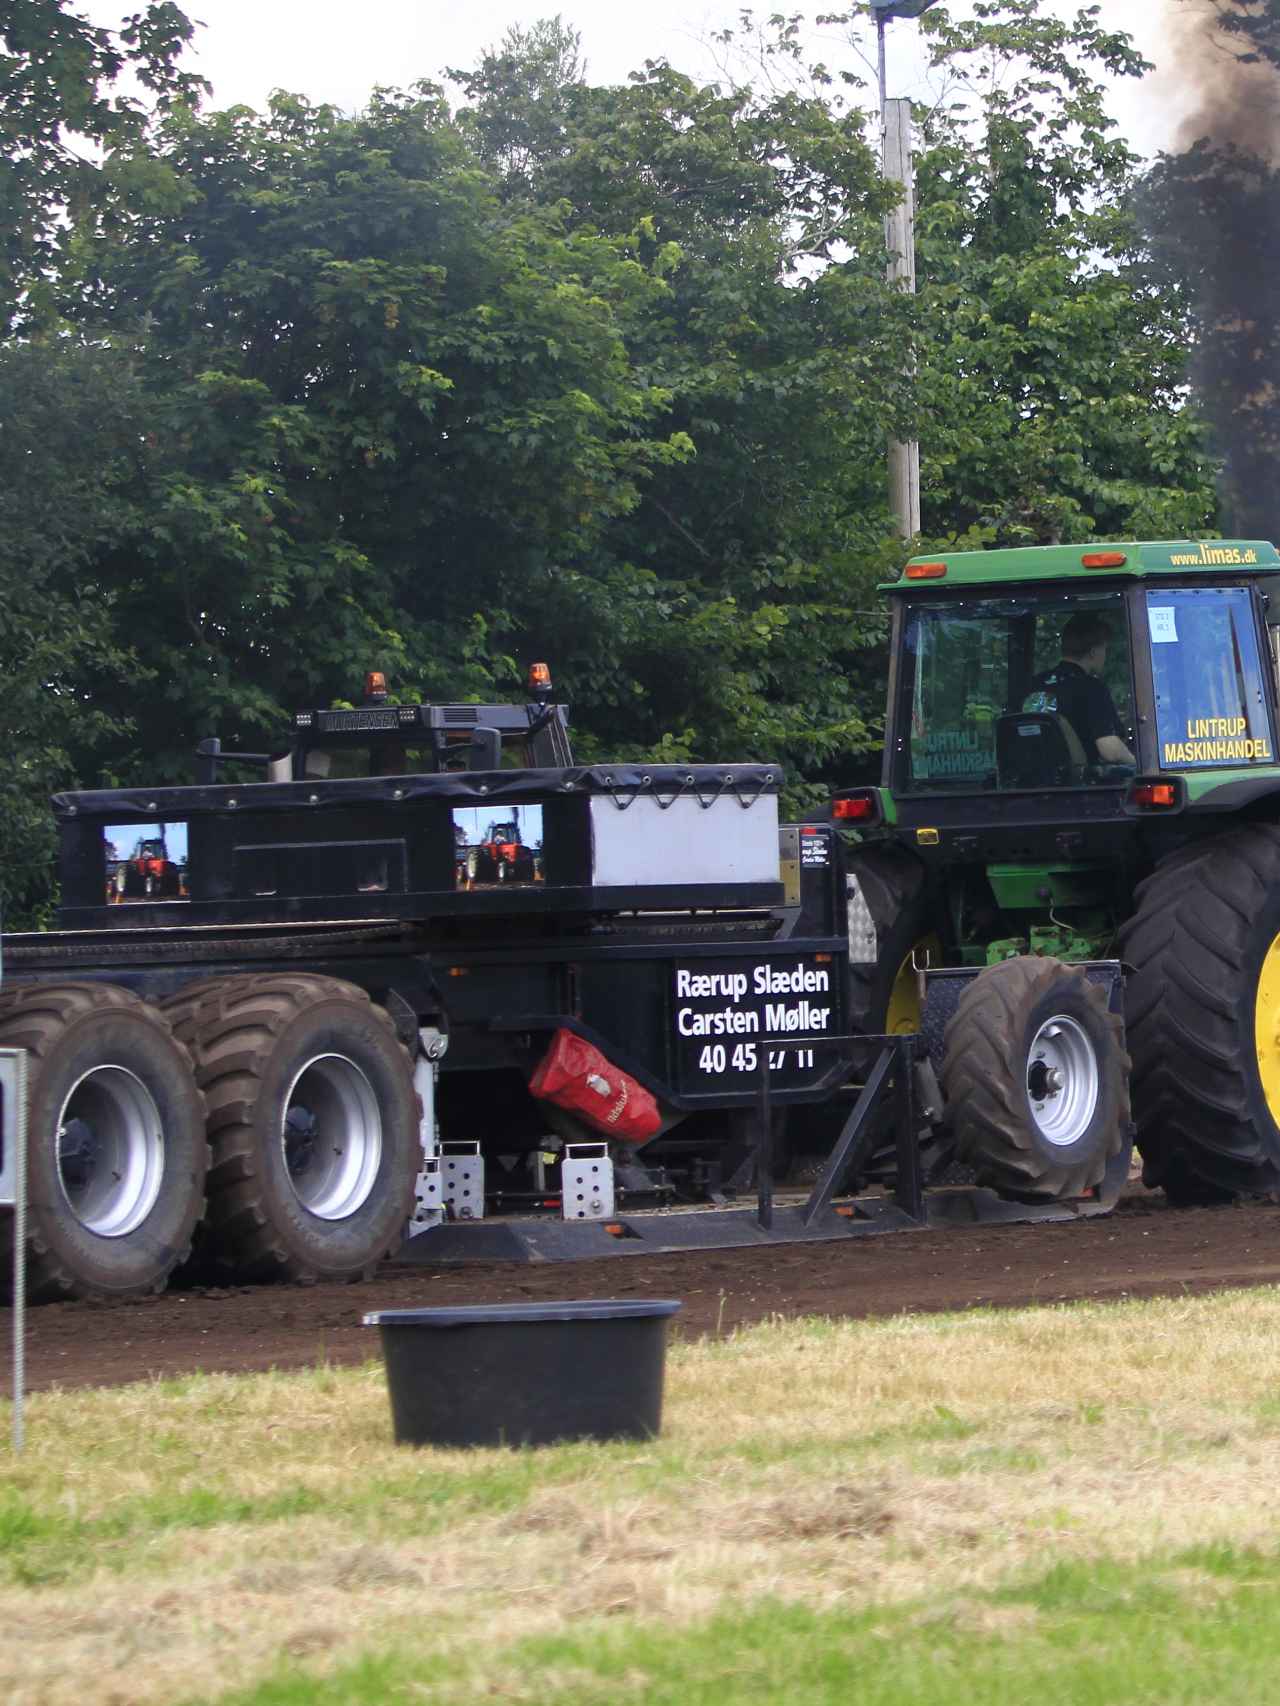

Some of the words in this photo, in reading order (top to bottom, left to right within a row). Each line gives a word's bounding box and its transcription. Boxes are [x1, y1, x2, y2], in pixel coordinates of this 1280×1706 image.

[1170, 544, 1257, 566] www.limas.dk
[1187, 718, 1247, 738] LINTRUP
[1165, 739, 1271, 763] MASKINHANDEL
[677, 969, 748, 1003] Rærup
[753, 963, 829, 995] Slæden
[678, 1006, 759, 1037] Carsten
[765, 1000, 830, 1032] Møller
[699, 1044, 727, 1074] 40
[732, 1042, 758, 1072] 45
